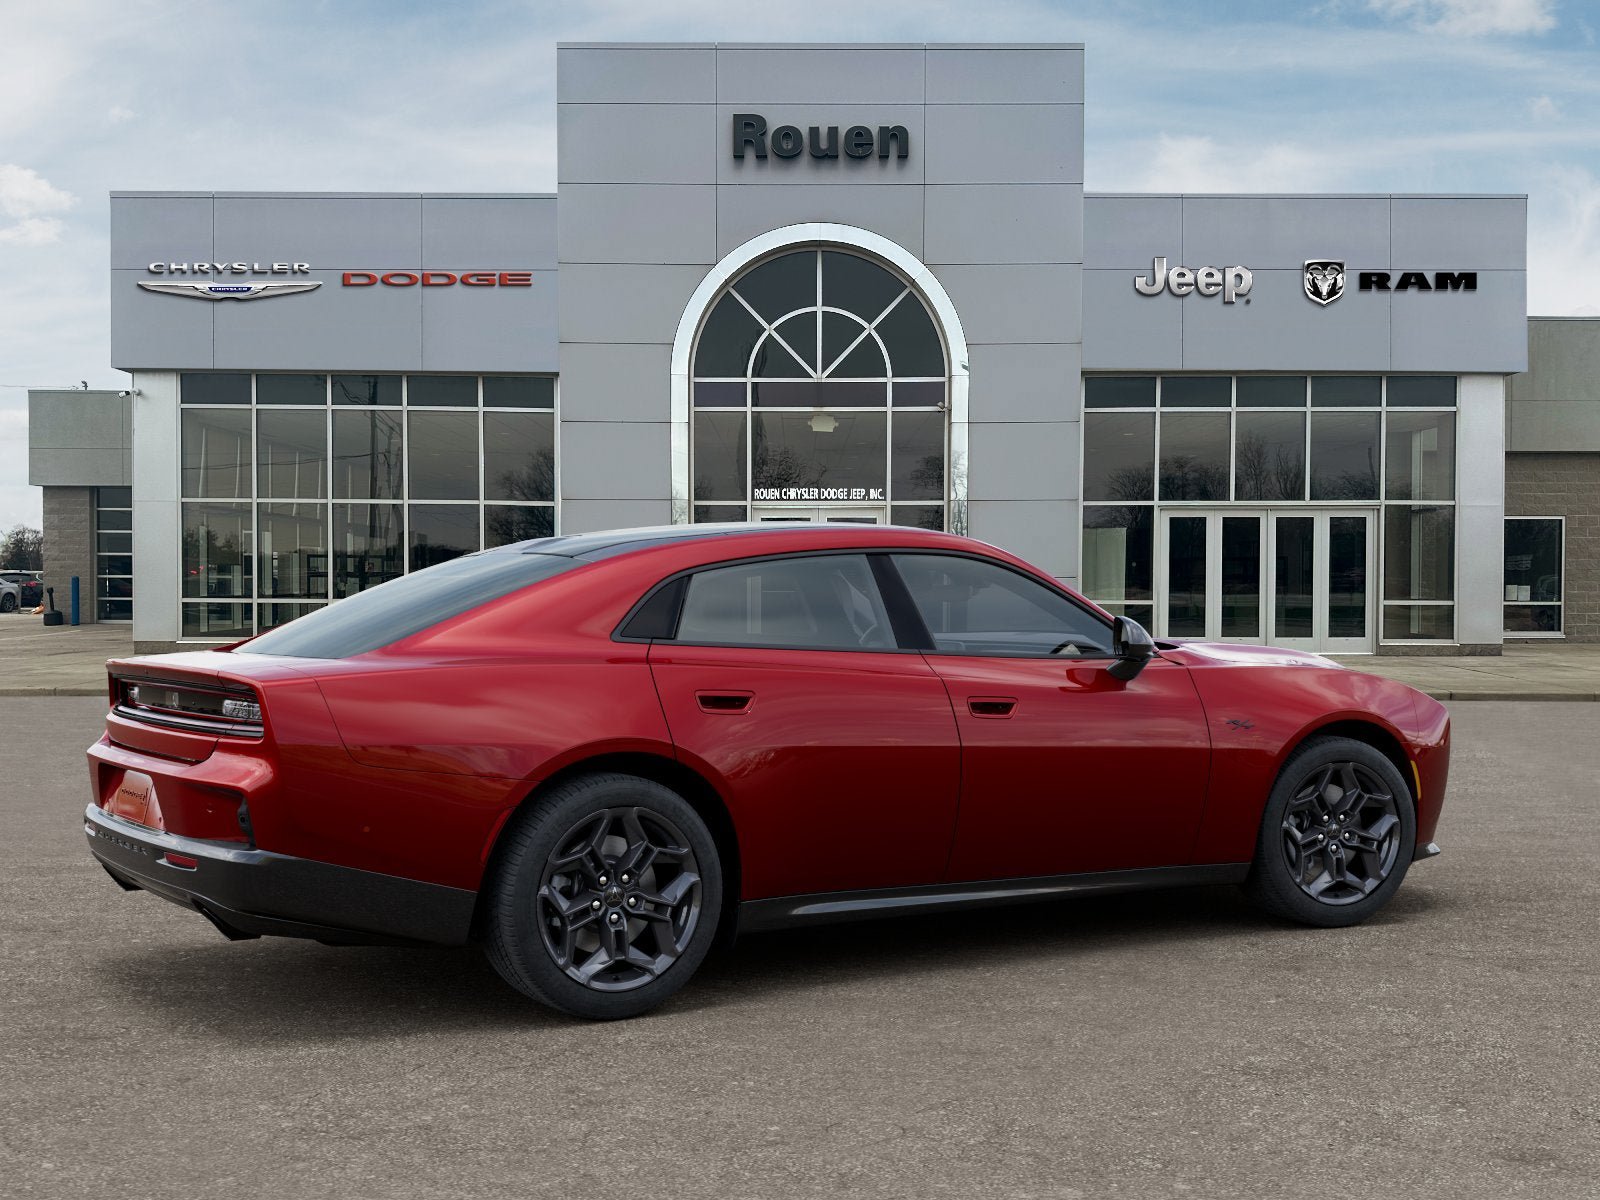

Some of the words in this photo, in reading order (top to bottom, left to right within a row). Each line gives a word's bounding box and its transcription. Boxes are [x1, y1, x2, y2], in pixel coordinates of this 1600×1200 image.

[732, 113, 910, 159] Rouen
[147, 261, 312, 275] CHRYSLER
[342, 271, 533, 287] DODGE
[1135, 256, 1253, 304] Jeep
[1358, 272, 1478, 292] RAM
[754, 488, 780, 500] ROUEN
[781, 488, 819, 500] CHRYSLER
[820, 488, 848, 500] DODGE
[849, 488, 868, 501] JEEP,
[869, 488, 885, 500] INC.
